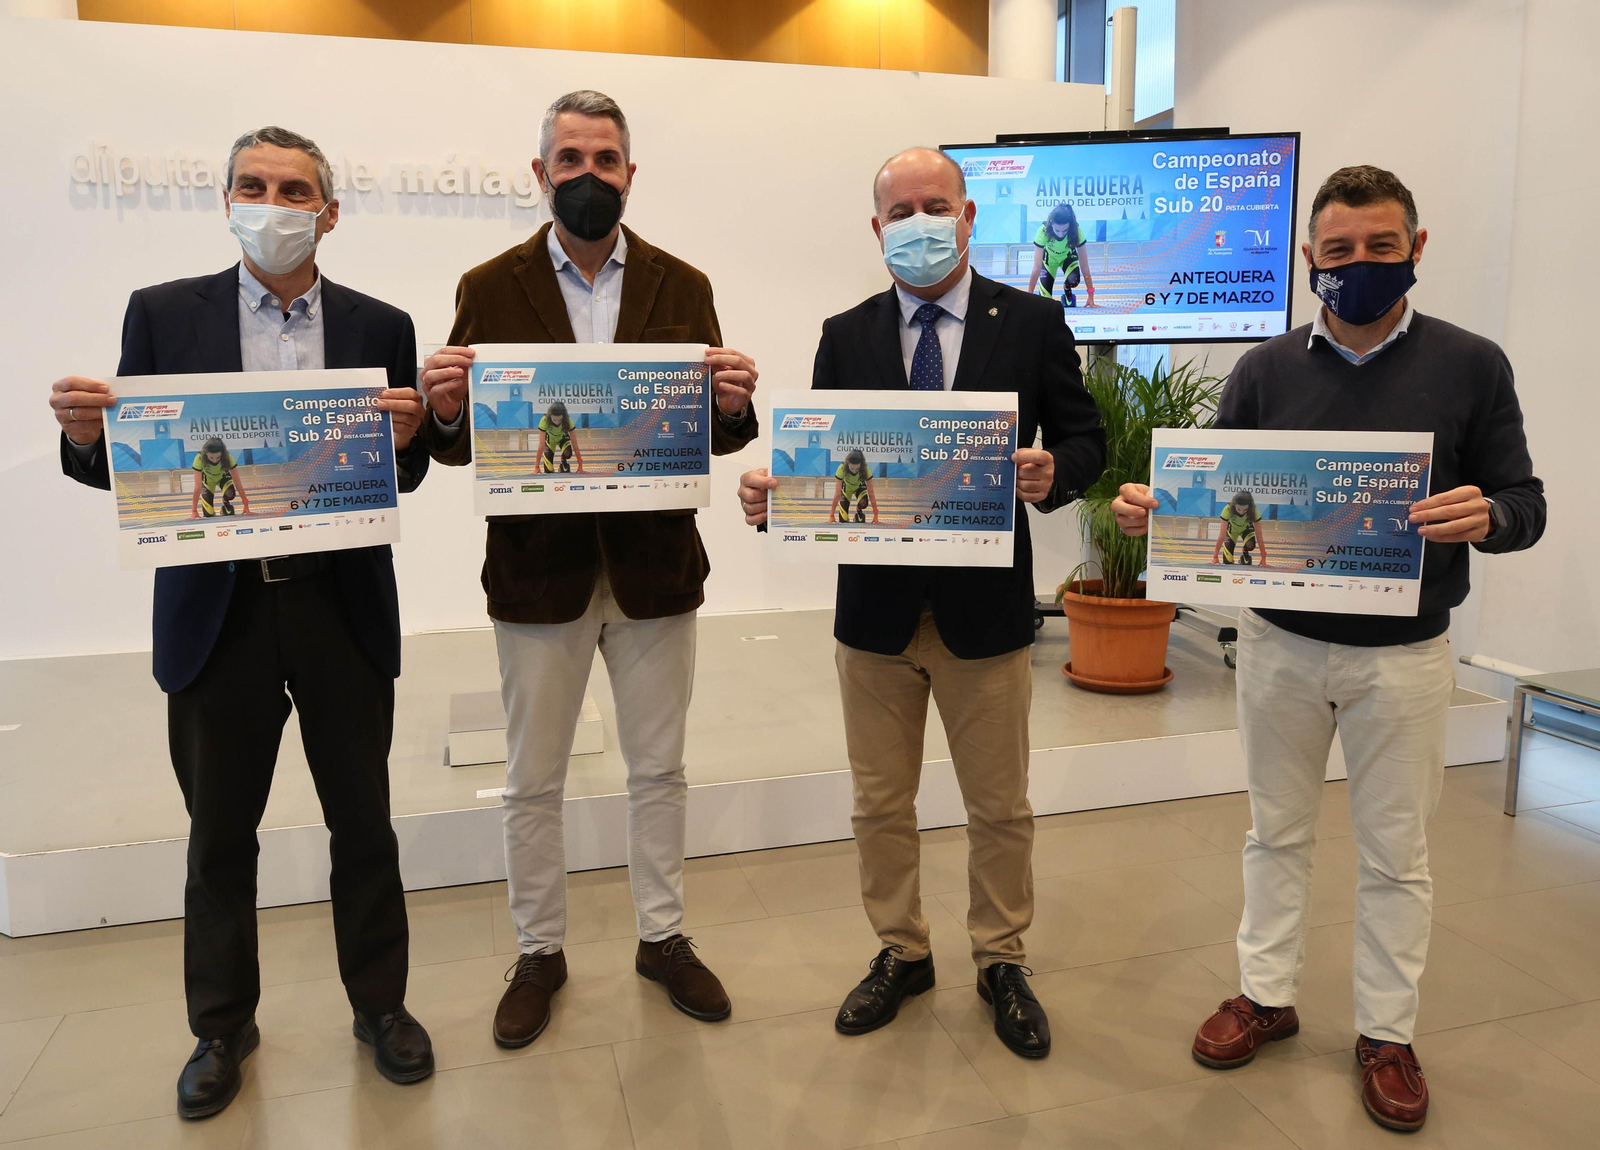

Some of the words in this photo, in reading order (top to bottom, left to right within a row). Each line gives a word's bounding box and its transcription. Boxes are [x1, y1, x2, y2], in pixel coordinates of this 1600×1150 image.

[1152, 149, 1282, 172] Campeonato
[332, 154, 373, 191] de
[390, 153, 541, 207] málag
[1036, 175, 1144, 197] ANTEQUERA
[1174, 173, 1199, 190] de
[1205, 171, 1280, 192] España
[1036, 199, 1074, 207] CIUDAD
[1077, 198, 1096, 206] DEL
[1098, 197, 1144, 206] DEPORTE
[1154, 197, 1193, 214] Sub
[1200, 196, 1223, 212] 20
[1169, 270, 1275, 285] ANTEQUERA
[1145, 293, 1156, 306] 6
[1160, 293, 1171, 305] Y
[1174, 292, 1184, 304] 7
[1187, 292, 1209, 304] DE
[1213, 291, 1274, 304] MARZO
[618, 368, 702, 382] Campeonato
[538, 383, 613, 397] ANTEQUERA
[633, 383, 649, 394] de
[654, 383, 702, 396] España
[283, 395, 380, 412] Campeonato
[620, 398, 647, 410] Sub
[651, 398, 666, 409] 20
[190, 414, 279, 433] ANTEQUERA
[302, 413, 321, 425] de
[326, 410, 383, 426] España
[919, 417, 1009, 432] Campeonato
[225, 432, 241, 440] DEL
[243, 431, 280, 439] DEPORTE
[288, 430, 319, 443] Sub
[324, 428, 342, 441] 20
[837, 431, 913, 446] ANTEQUERA
[935, 433, 951, 444] de
[956, 433, 1009, 447] España
[634, 448, 702, 457] ANTEQUERA
[920, 448, 948, 460] Sub
[952, 449, 969, 460] 20
[617, 462, 624, 472] 6
[627, 463, 634, 471] Y
[637, 463, 643, 471] 7
[646, 462, 660, 471] DE
[663, 461, 702, 470] MARZO
[1315, 458, 1420, 474] Campeonato
[308, 479, 388, 494] ANTEQUERA
[1223, 471, 1308, 488] ANTEQUERA
[1332, 474, 1352, 487] de
[1358, 475, 1418, 490] España
[1271, 488, 1308, 496] DEPORTE
[1316, 490, 1347, 503] Sub
[1352, 492, 1371, 504] 20
[290, 501, 299, 510] 6
[302, 500, 310, 508] Y
[313, 499, 320, 508] 7
[324, 497, 339, 507] DE
[344, 493, 388, 506] MARZO
[931, 501, 1006, 511] ANTEQUERA
[914, 515, 922, 523] 6
[924, 515, 932, 524] Y
[935, 515, 942, 524] 7
[944, 515, 959, 524] DE
[962, 516, 1005, 525] MARZO
[1326, 545, 1412, 558] ANTEQUERA
[1306, 559, 1314, 568] 6
[1318, 560, 1327, 568] Y
[1330, 560, 1337, 569] 7
[1340, 561, 1357, 570] DE
[1361, 562, 1410, 573] MARZO
